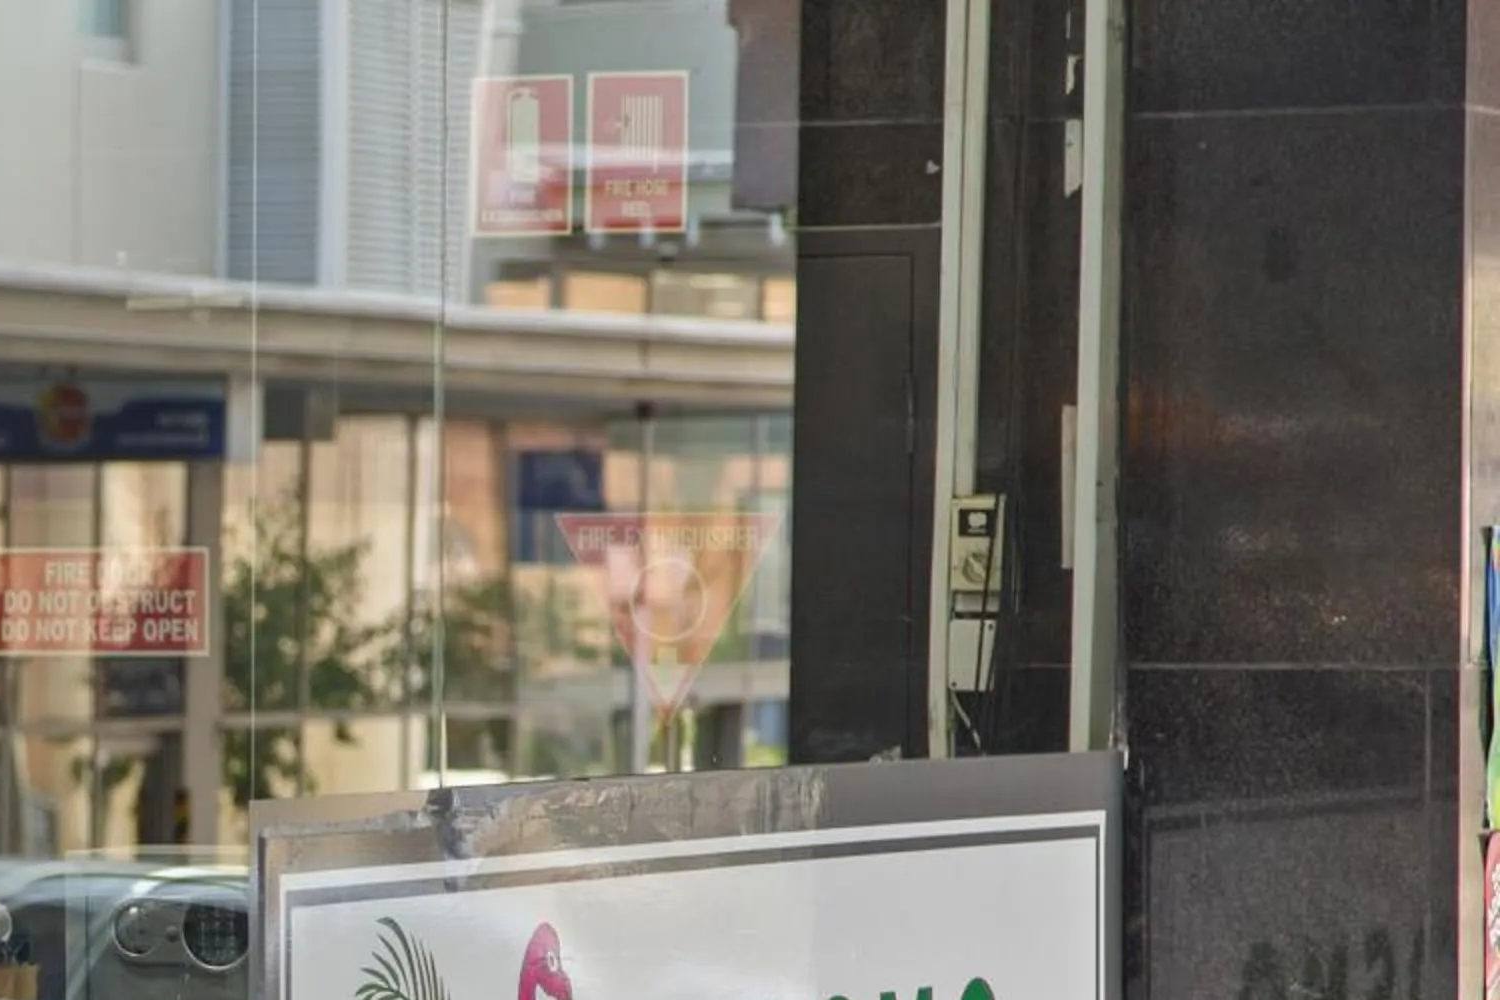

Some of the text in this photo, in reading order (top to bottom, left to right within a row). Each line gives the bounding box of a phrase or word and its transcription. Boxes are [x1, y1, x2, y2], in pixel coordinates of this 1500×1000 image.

[45, 561, 90, 586] FIRE
[5, 588, 197, 614] DO NOT OBSTRUCT
[2, 617, 200, 643] DO NOT KEEP OPEN
